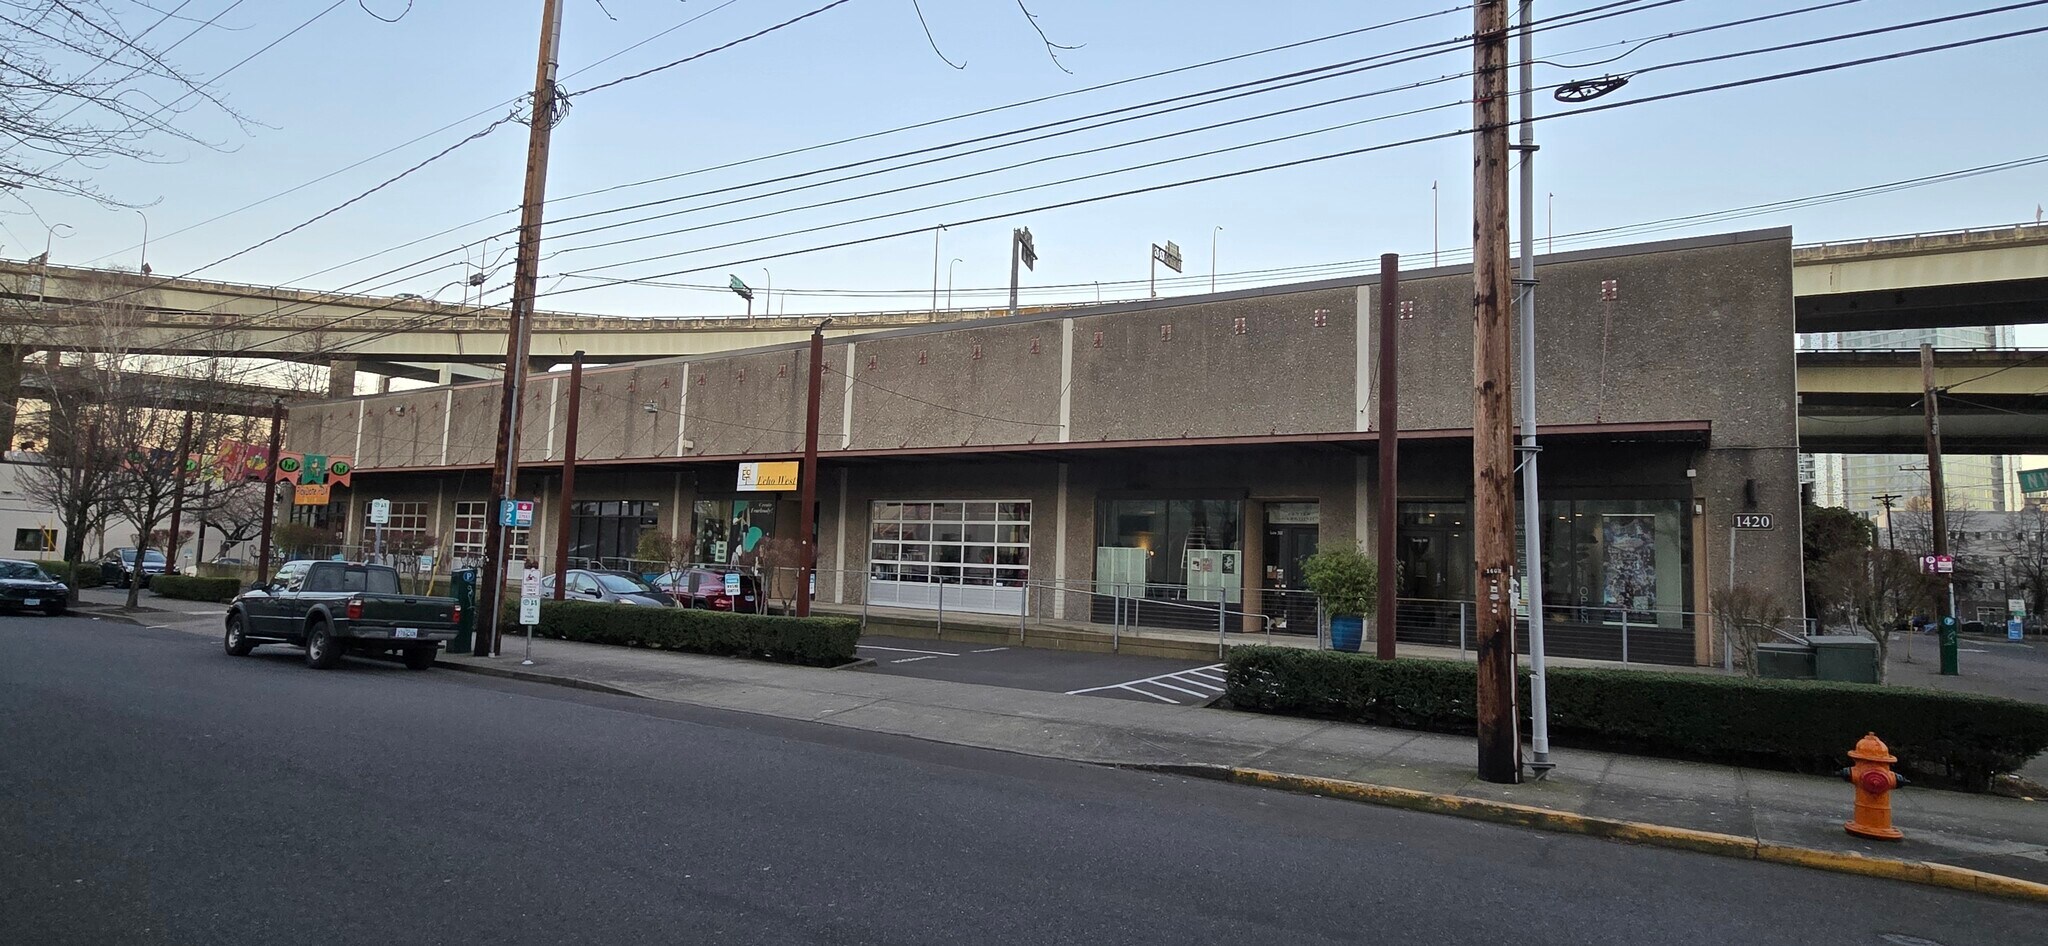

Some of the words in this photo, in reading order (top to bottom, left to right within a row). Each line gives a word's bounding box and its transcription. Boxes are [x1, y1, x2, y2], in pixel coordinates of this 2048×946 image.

[757, 475, 776, 486] Echo
[777, 475, 797, 486] West
[505, 512, 512, 523] 2
[1736, 515, 1770, 528] 1420
